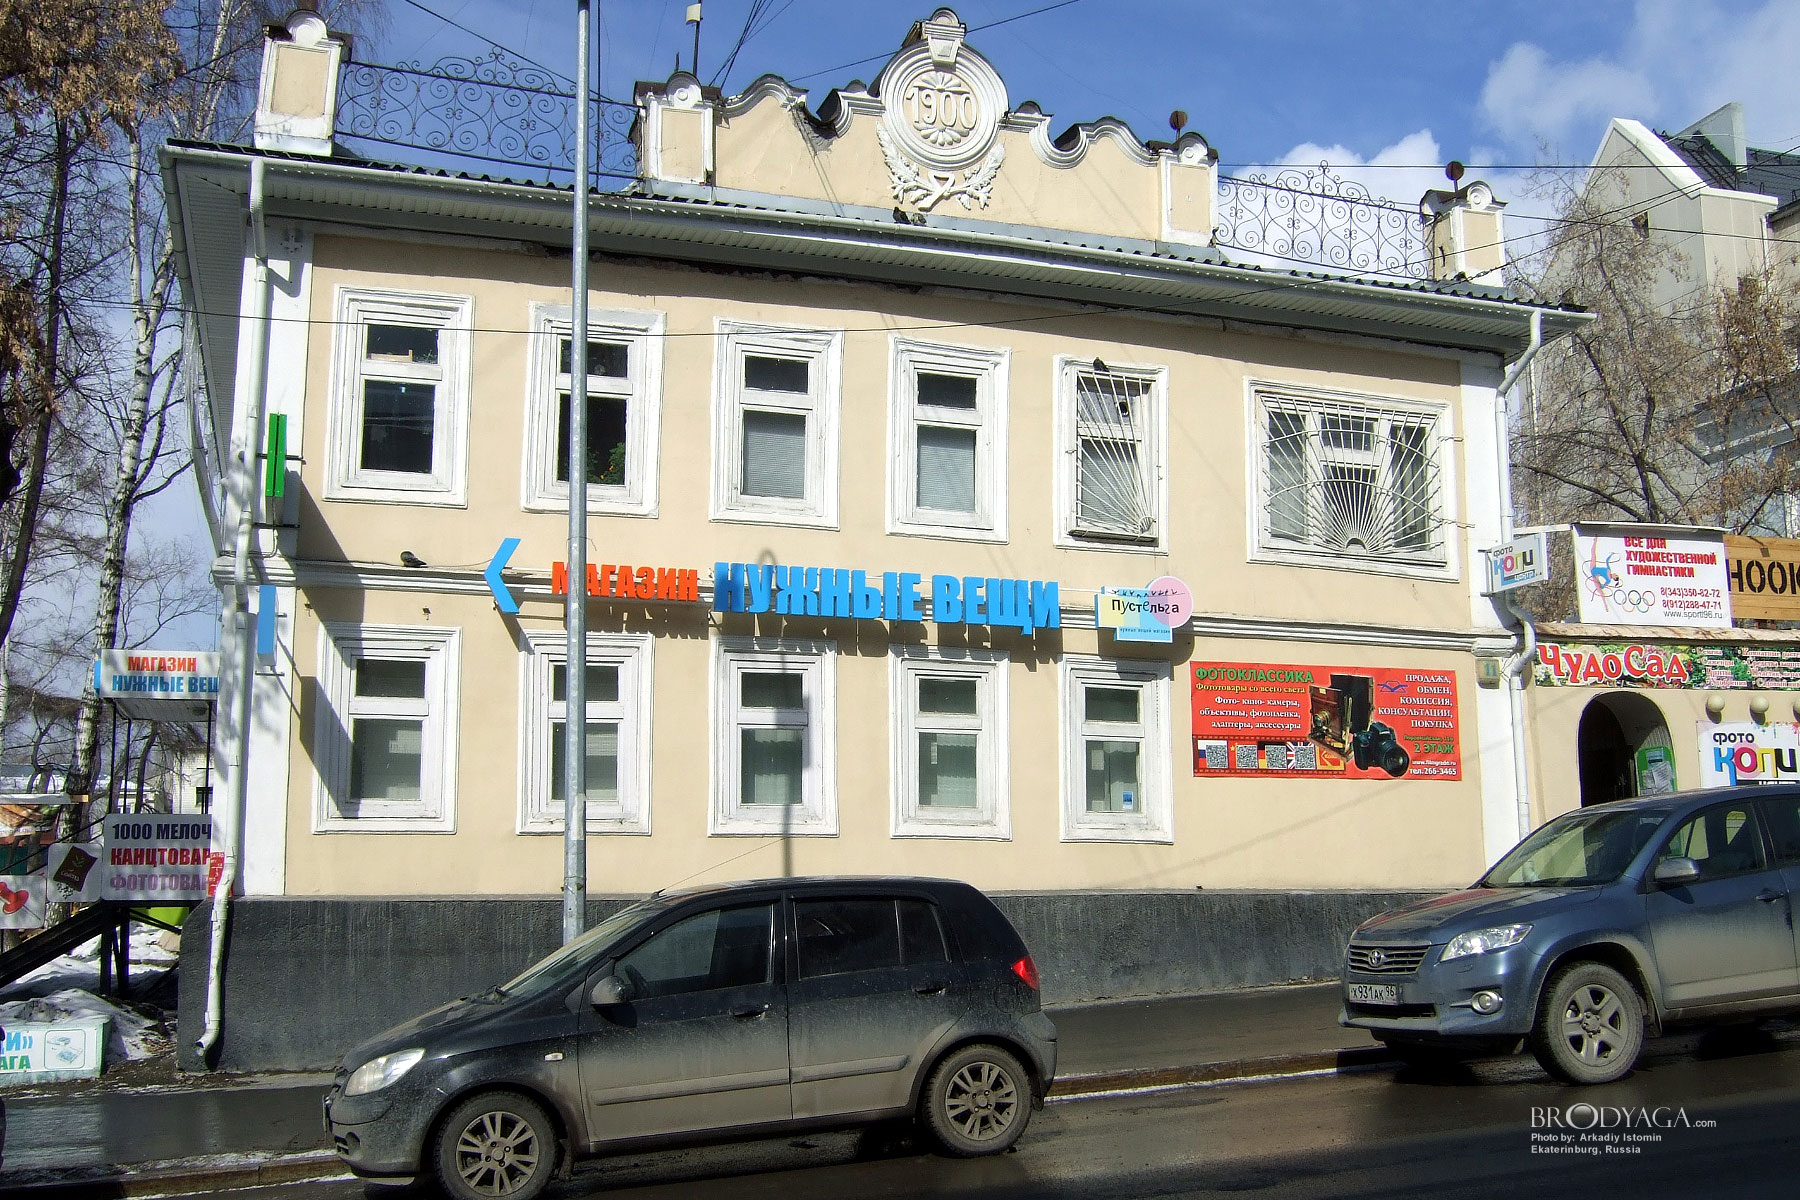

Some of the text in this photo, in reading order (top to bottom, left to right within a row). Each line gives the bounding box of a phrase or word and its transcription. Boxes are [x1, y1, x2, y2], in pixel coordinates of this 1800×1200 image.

[906, 86, 978, 129] 1900
[1624, 536, 1667, 549] ВСЕ ДЛЯ
[1625, 550, 1717, 565] ХУДОЖЕСТВЕННОЙ
[1626, 564, 1695, 578] ГИМНАСТИКИ
[552, 562, 1061, 635] МАГАЗИН НУЖНЫЕ ВЕЩИ
[1112, 599, 1179, 614] Пустельга
[128, 656, 197, 672] МАГАЗИН
[1195, 667, 1314, 683] ФОТОКЛАССИКА
[1405, 674, 1452, 684] ПРОДАЖА,
[112, 675, 184, 692] НУЖНЫЕ
[1196, 683, 1247, 693] Фототовары
[1417, 685, 1453, 695] ОБМЕН,
[1400, 696, 1453, 706] КОМИССИЯ,
[1200, 707, 1248, 717] объективы,
[1378, 707, 1453, 718] КОНСУЛЬТАЦИИ,
[1212, 721, 1301, 731] адаптеры, аксессуары
[1411, 719, 1454, 729] ПОКУПКА
[1414, 743, 1454, 753] 2 ЭТАЖ
[112, 823, 212, 840] 1000 МЕЛОЧ
[110, 848, 211, 867] КАНЦТОВАР
